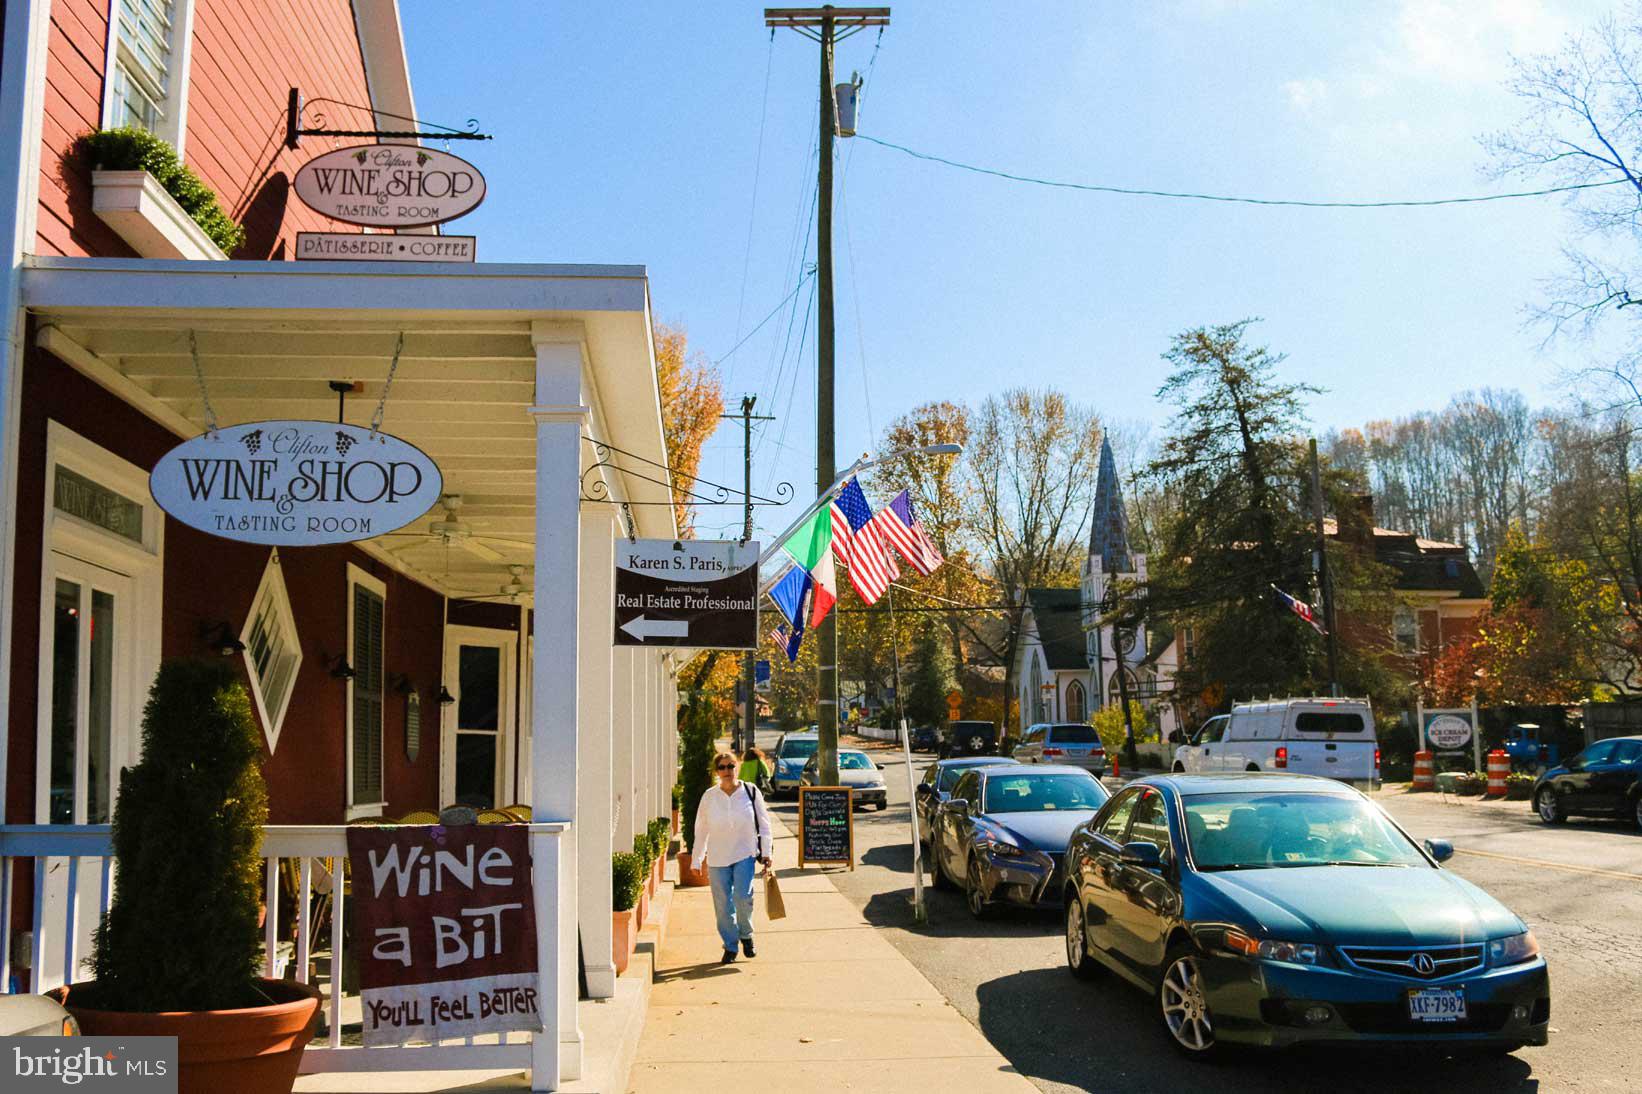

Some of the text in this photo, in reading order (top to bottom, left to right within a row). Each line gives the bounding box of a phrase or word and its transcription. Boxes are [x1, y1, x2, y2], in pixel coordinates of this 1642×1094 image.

[371, 149, 412, 171] Clifton
[312, 168, 473, 198] WINE SHOP
[376, 191, 388, 205] &
[336, 204, 440, 218] TASTING ROOM
[304, 237, 468, 256] PÂTISSERIE COFFEE
[268, 428, 329, 462] Clifton
[178, 458, 422, 504] WINE SHOP
[276, 494, 294, 515] &
[214, 514, 371, 533] TASTING ROOM
[628, 555, 669, 570] Karen
[673, 556, 685, 570] S.
[690, 557, 727, 573] Paris,
[617, 593, 755, 611] Real Estate Professional
[372, 927, 412, 968] a
